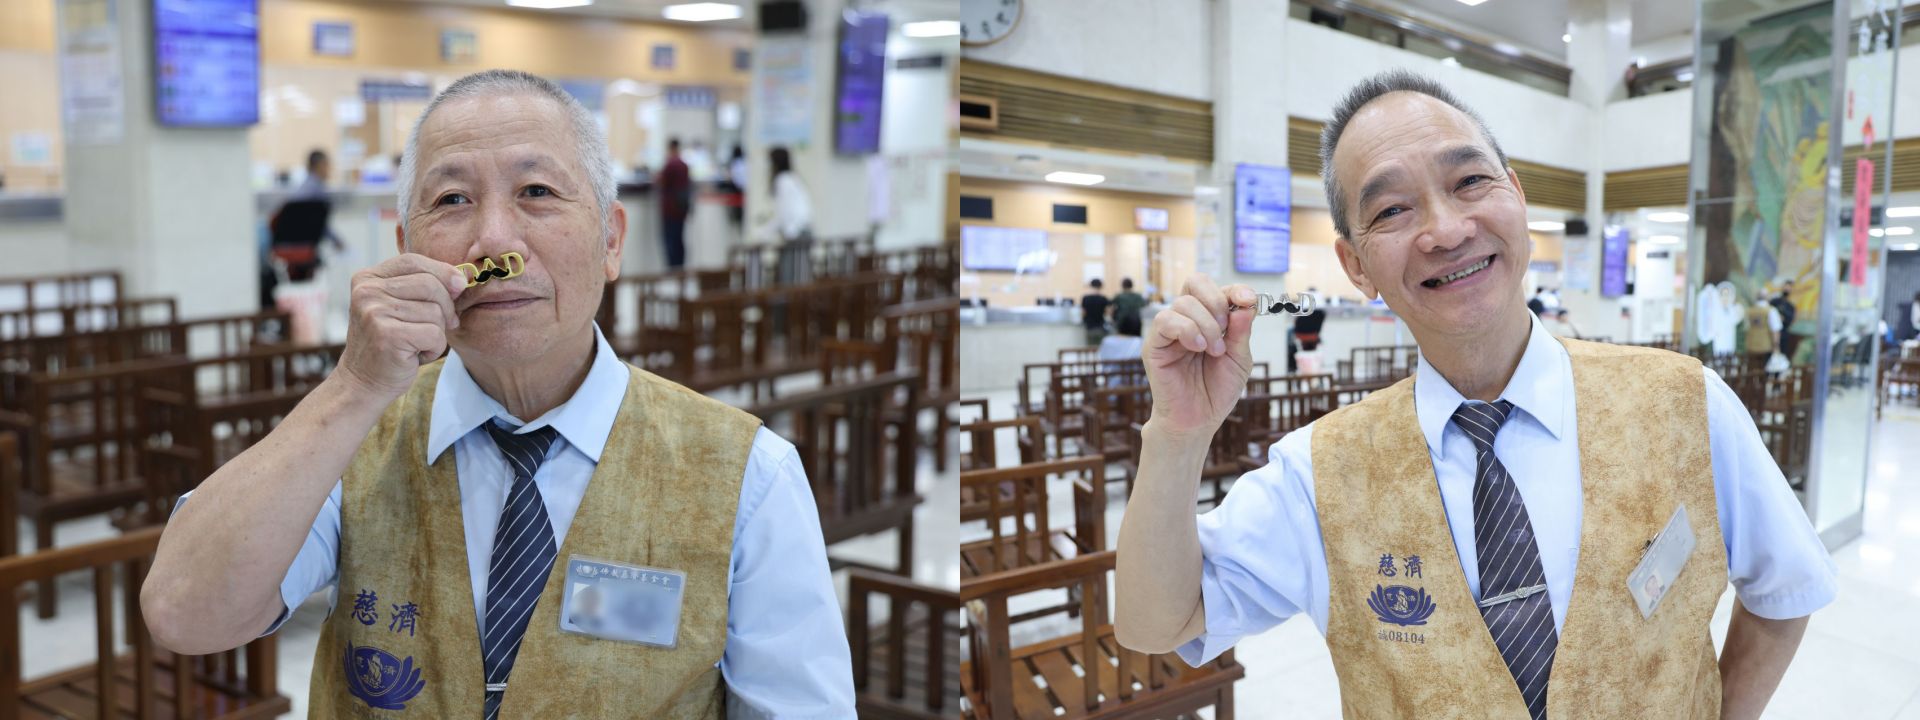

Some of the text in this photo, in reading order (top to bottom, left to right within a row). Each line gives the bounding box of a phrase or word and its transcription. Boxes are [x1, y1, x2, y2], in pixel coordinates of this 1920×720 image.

[455, 252, 525, 288] DAD
[1257, 292, 1316, 317] DAD
[1378, 553, 1423, 579] 慈濟
[351, 589, 420, 637] 慈濟
